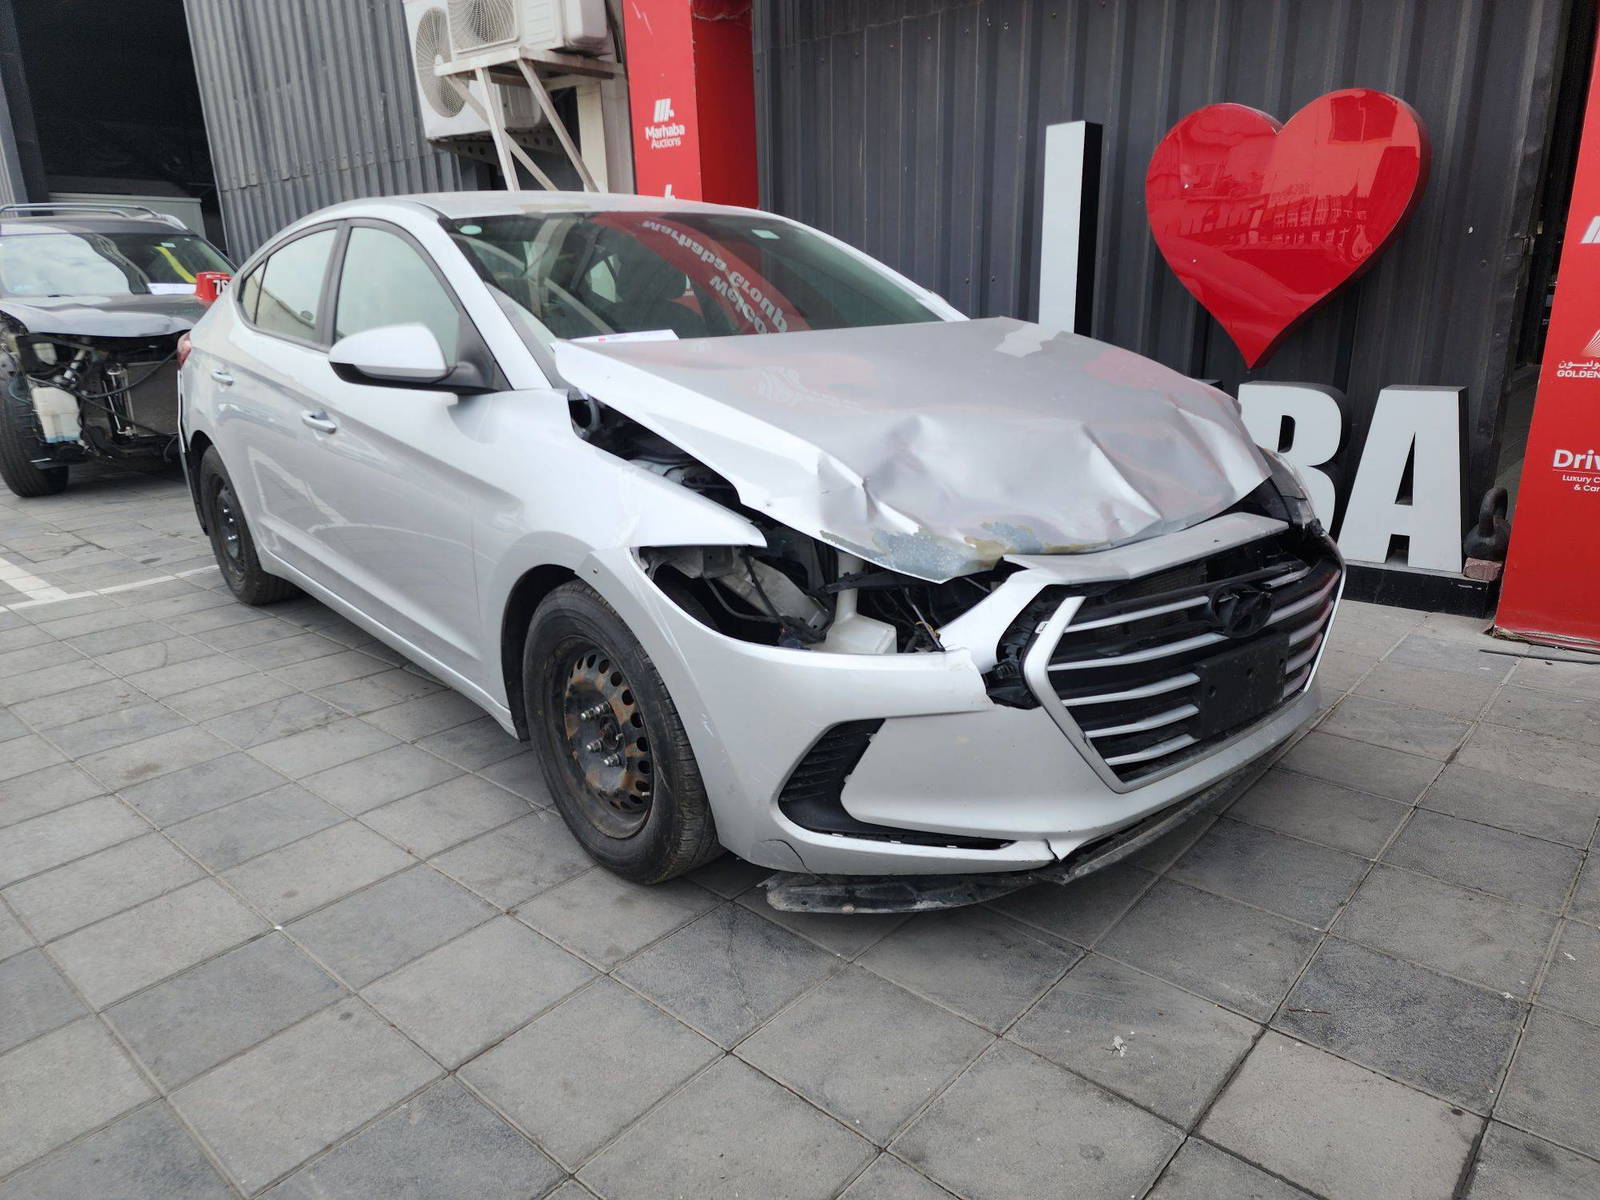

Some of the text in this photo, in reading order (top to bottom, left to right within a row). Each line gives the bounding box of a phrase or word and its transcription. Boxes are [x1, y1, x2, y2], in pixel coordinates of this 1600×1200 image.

[645, 123, 686, 140] Marhaba
[651, 137, 682, 150] Auctions
[1557, 370, 1600, 378] GOLDEN
[1562, 474, 1592, 485] Luxury
